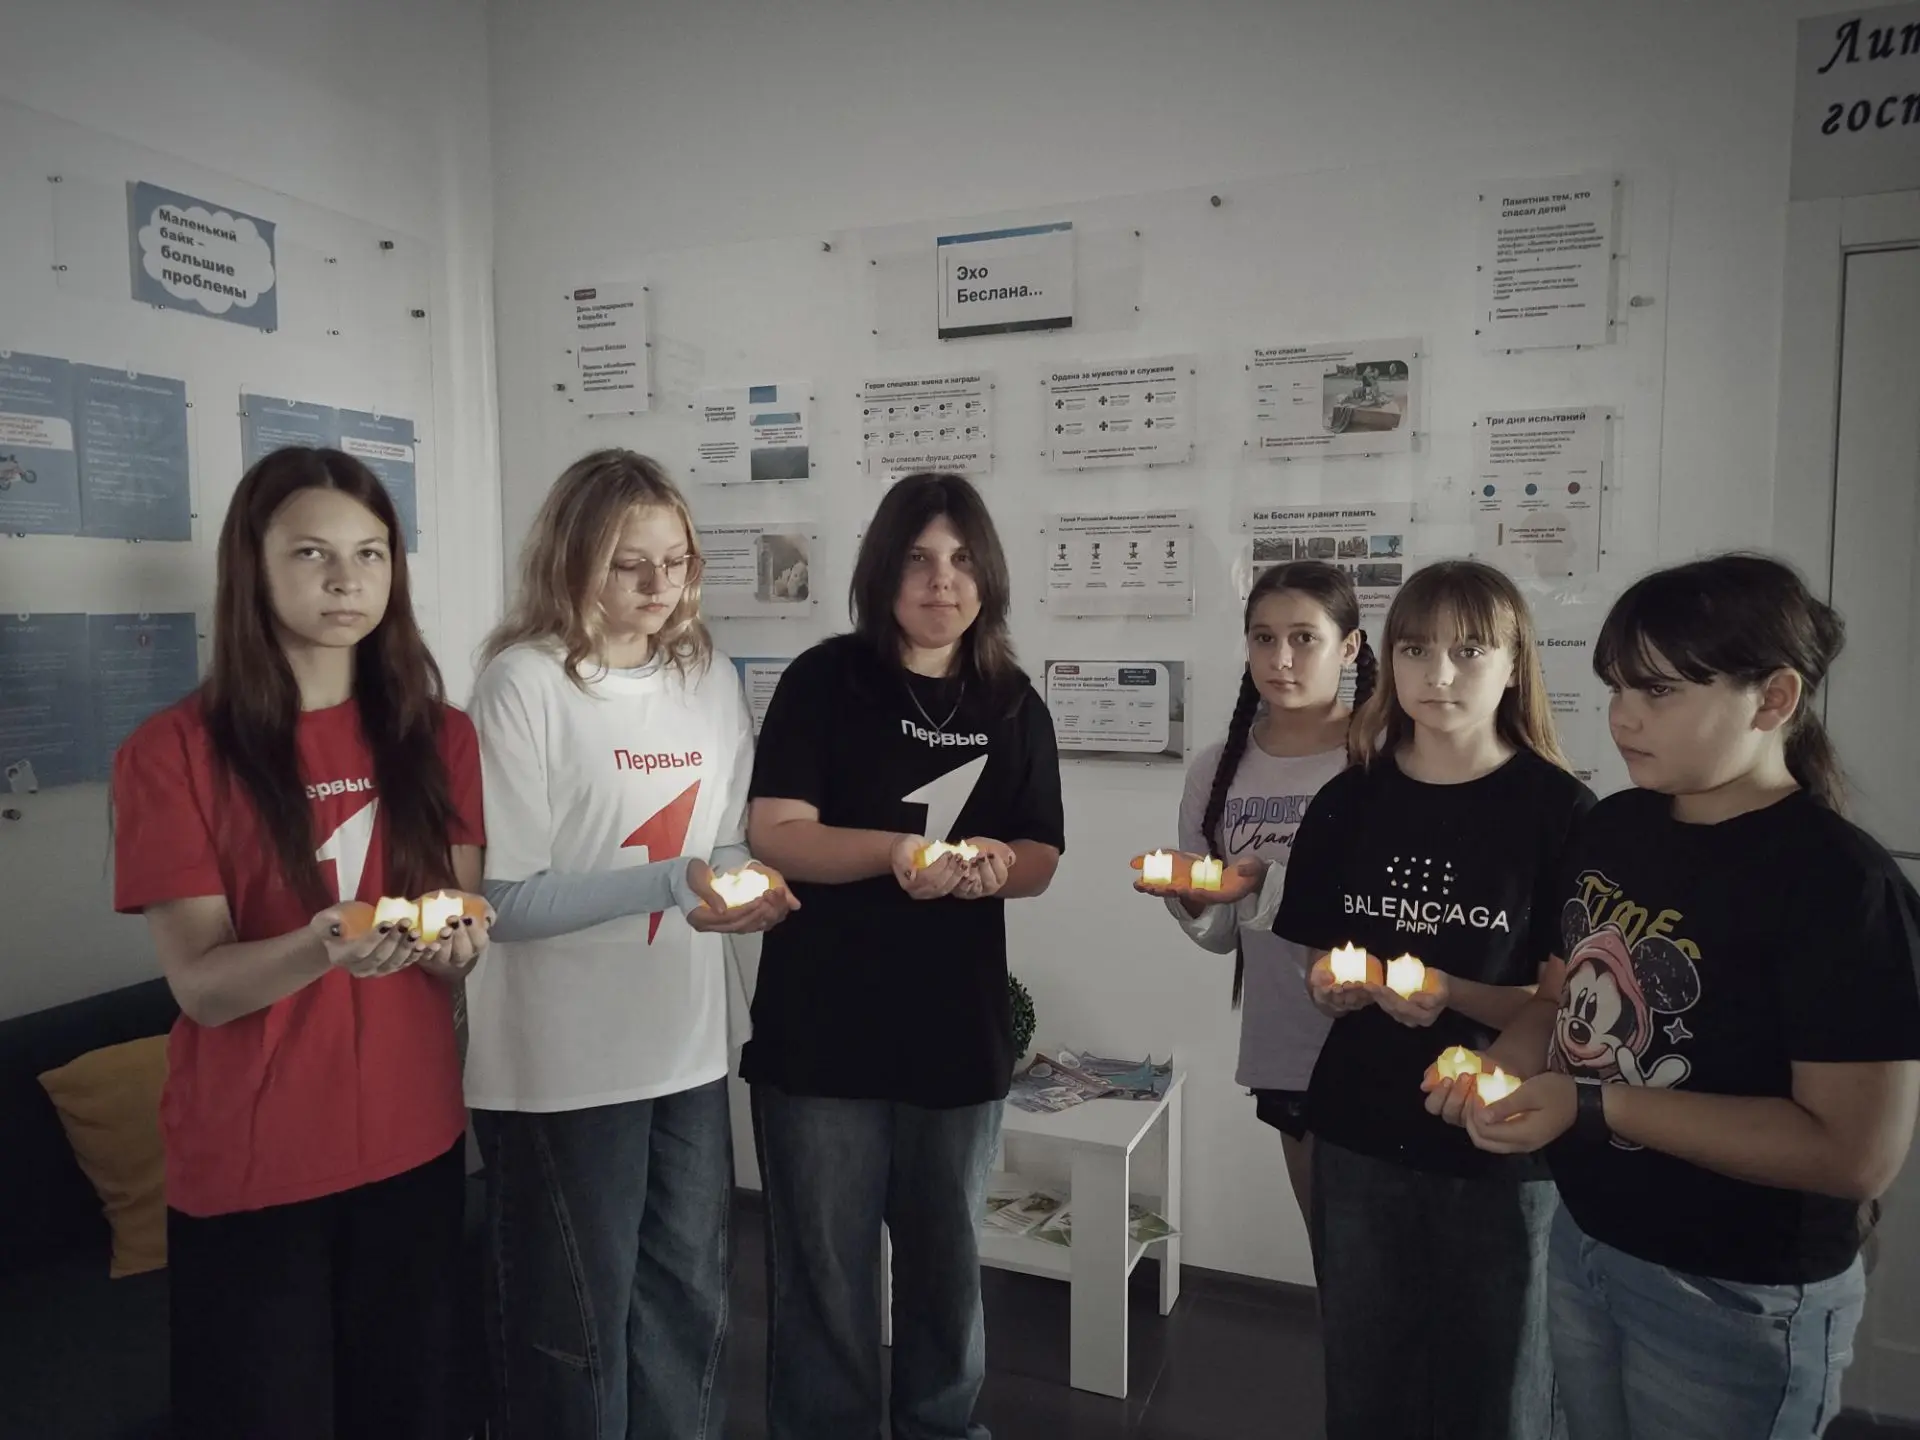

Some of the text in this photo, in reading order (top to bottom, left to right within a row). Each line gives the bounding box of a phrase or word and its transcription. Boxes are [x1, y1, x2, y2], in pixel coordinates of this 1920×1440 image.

[1574, 191, 1591, 199] кто
[1502, 204, 1567, 218] спасал детей
[158, 208, 237, 242] Маленький
[159, 227, 194, 246] байк
[160, 245, 235, 277] большие
[956, 265, 989, 281] Эхо
[161, 268, 247, 299] проблемы
[950, 375, 981, 384] награды
[1051, 373, 1080, 382] Ордена
[1486, 412, 1586, 427] Три дня испытаний
[1253, 509, 1377, 520] Как Беслан хранит память
[1547, 638, 1587, 647] Беслан
[900, 719, 989, 748] Первые
[614, 749, 703, 774] Первые
[1226, 795, 1315, 829] ROOK
[1229, 813, 1295, 855] Cham
[1344, 893, 1510, 933] BALENCIAGA
[1395, 919, 1439, 936] PNPN
